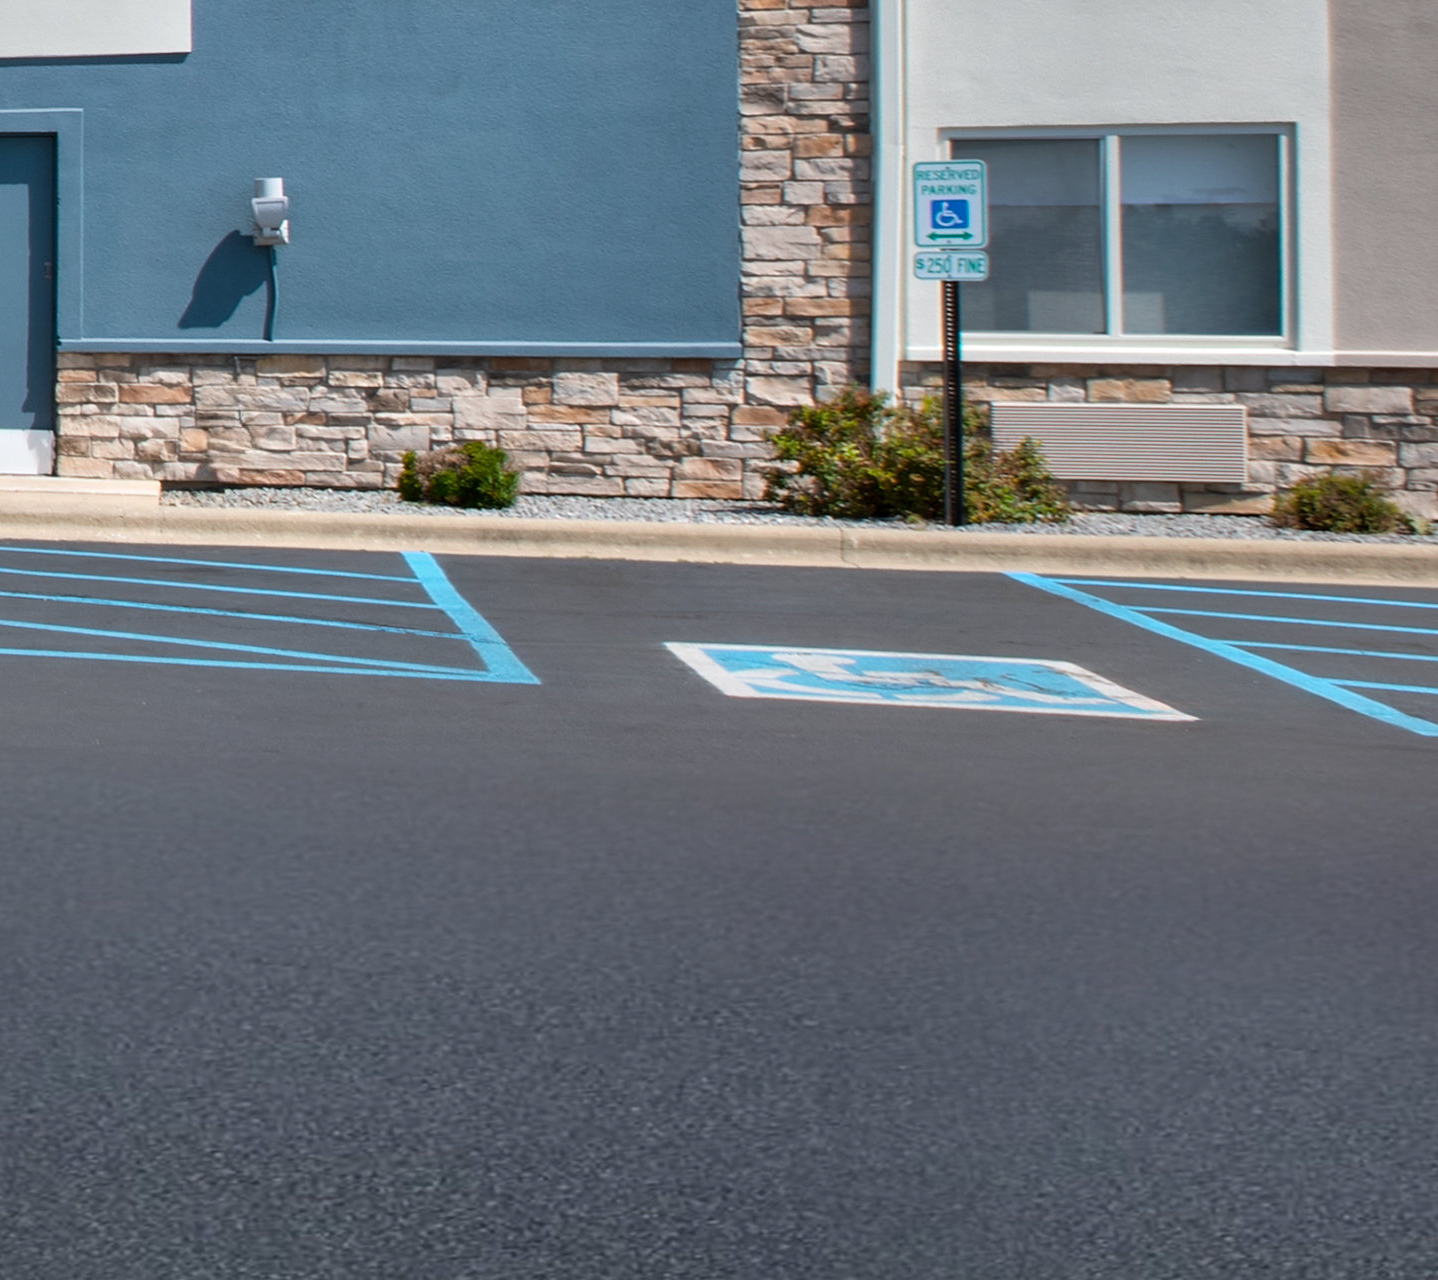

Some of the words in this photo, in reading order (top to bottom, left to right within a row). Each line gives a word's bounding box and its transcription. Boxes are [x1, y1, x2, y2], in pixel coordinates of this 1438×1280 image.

[916, 169, 980, 181] RESERVED
[921, 184, 977, 195] PARKING
[957, 258, 985, 274] FINE
